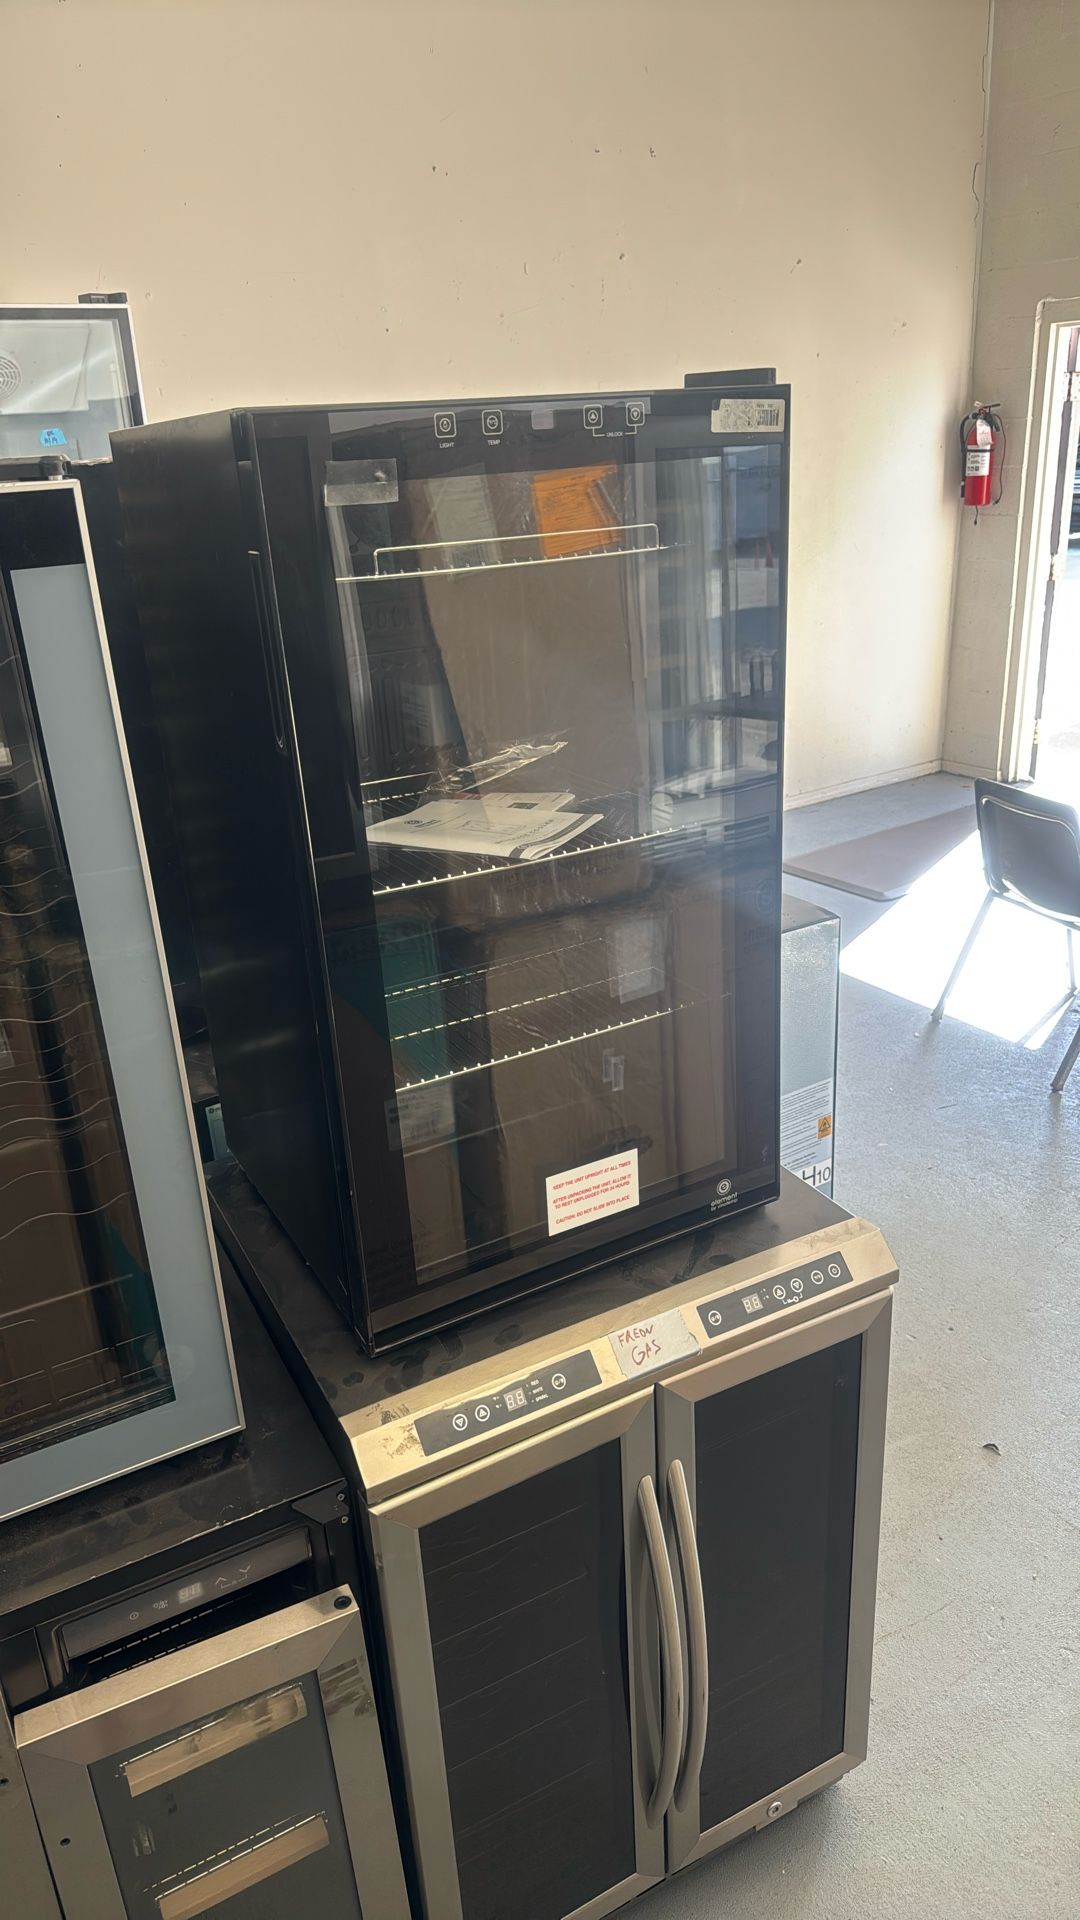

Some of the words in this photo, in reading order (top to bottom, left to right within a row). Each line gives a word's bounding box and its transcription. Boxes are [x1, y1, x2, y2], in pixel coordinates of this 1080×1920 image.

[585, 1168, 603, 1179] UPRIGHT
[618, 1160, 631, 1168] TIMES
[553, 1196, 566, 1204] AFTER
[568, 1186, 592, 1199] UNPACKING
[612, 1175, 627, 1184] ALLOW
[574, 1191, 600, 1203] UNPLUGGED
[615, 1181, 630, 1189] HOURS
[616, 1195, 630, 1204] PLACE
[711, 1192, 737, 1206] element
[632, 1340, 661, 1365] GAS
